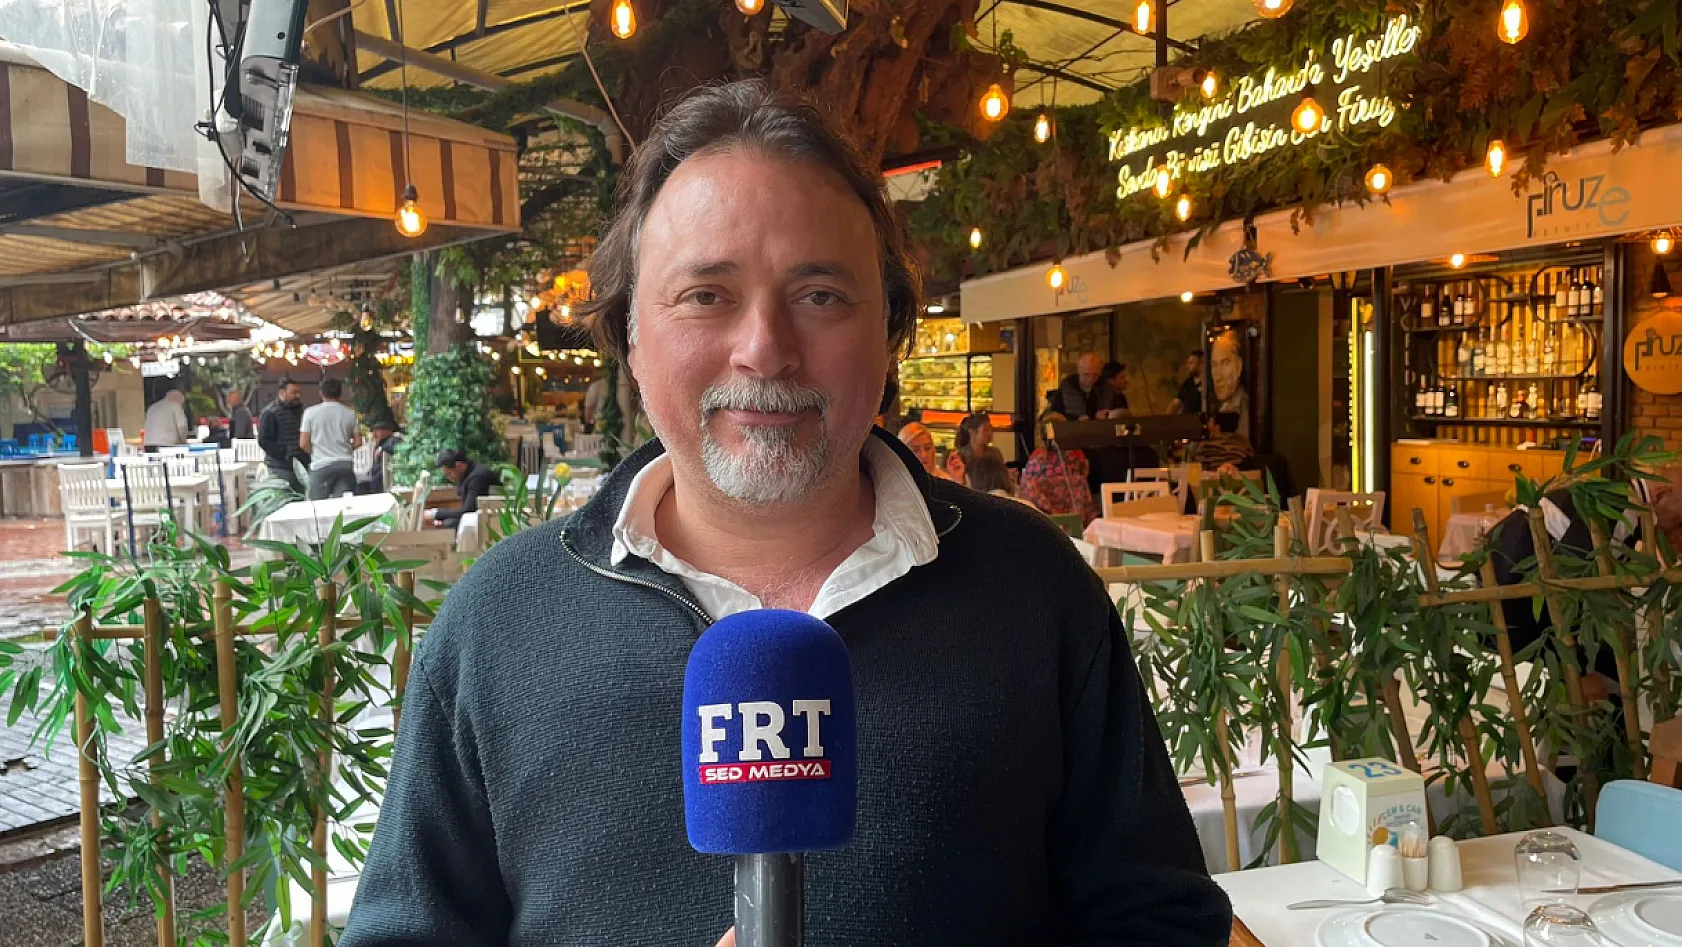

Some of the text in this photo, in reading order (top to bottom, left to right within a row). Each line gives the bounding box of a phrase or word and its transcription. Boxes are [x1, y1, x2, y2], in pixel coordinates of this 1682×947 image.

[699, 700, 831, 762] FRT
[705, 763, 826, 781] SED MEDYA
[1348, 761, 1402, 778] 23
